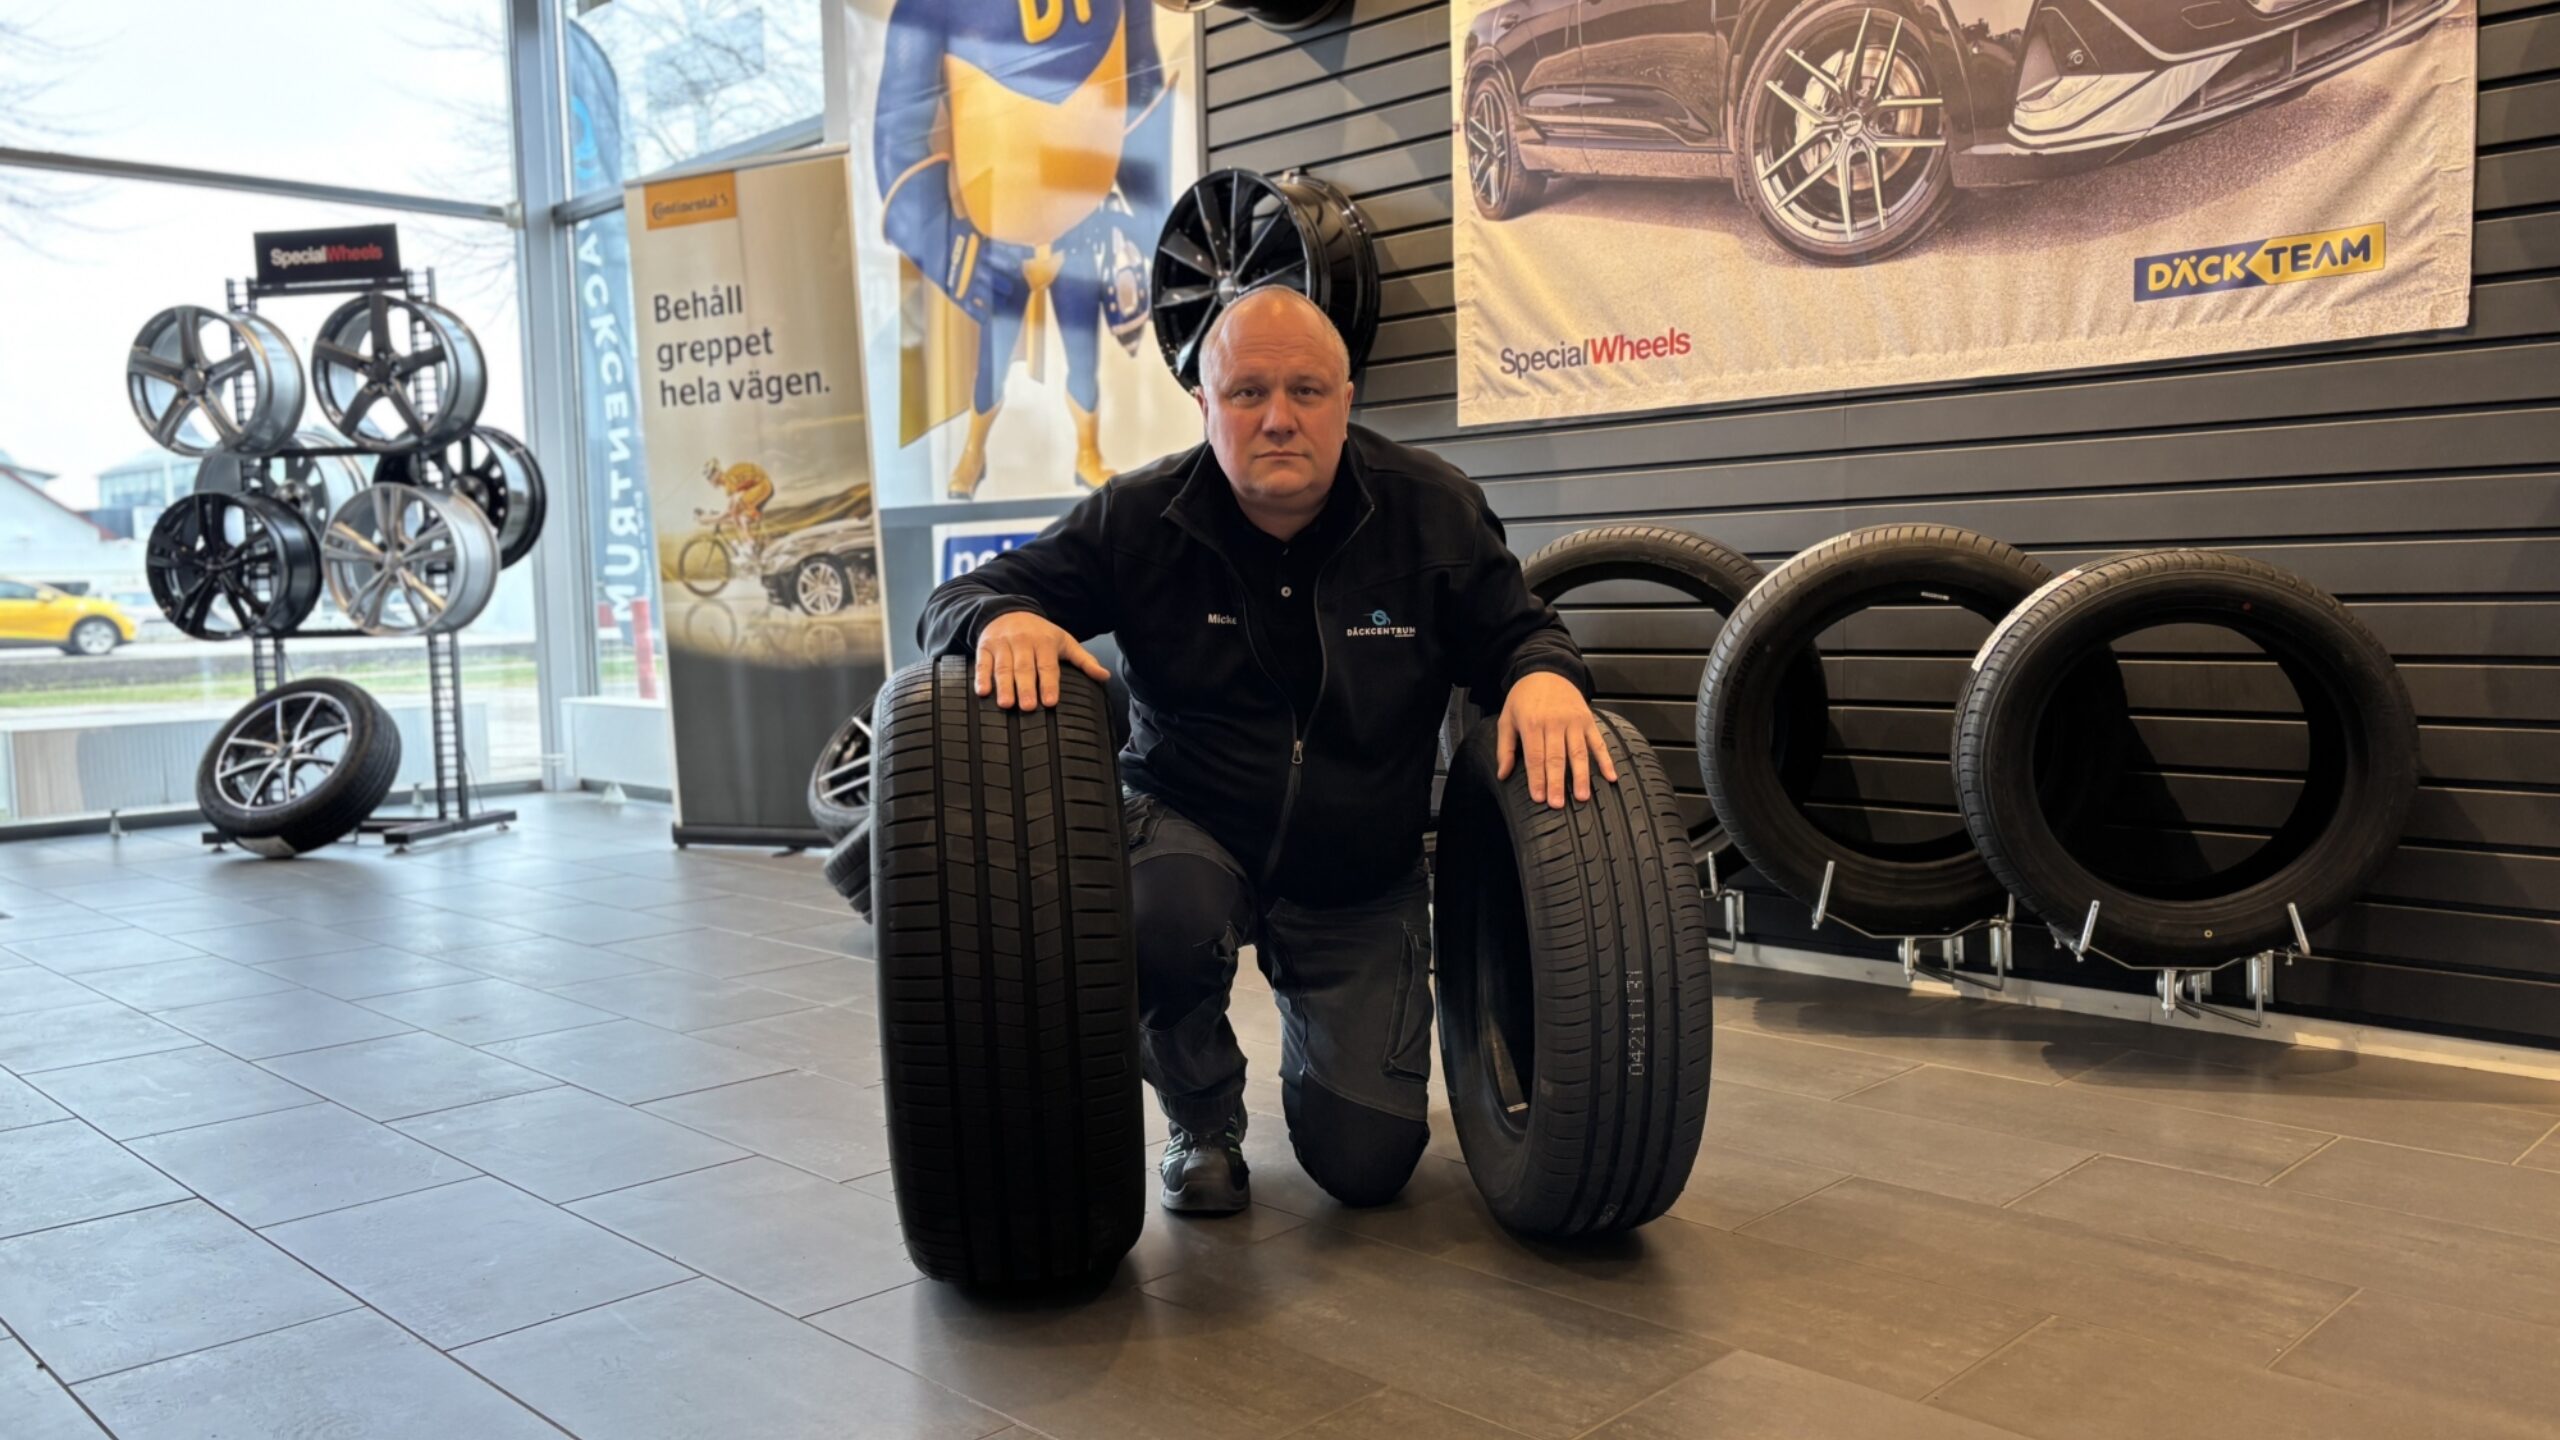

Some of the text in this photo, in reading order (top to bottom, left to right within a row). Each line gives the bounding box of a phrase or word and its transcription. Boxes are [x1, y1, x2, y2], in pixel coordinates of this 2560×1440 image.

[652, 193, 718, 221] Continental
[270, 243, 384, 268] SpecialWheels
[2148, 234, 2371, 292] DÄCK TEAM
[654, 284, 743, 323] Behåll
[657, 327, 774, 372] greppet
[1500, 327, 1691, 379] SpecialWheels
[660, 369, 830, 408] hela vägen.
